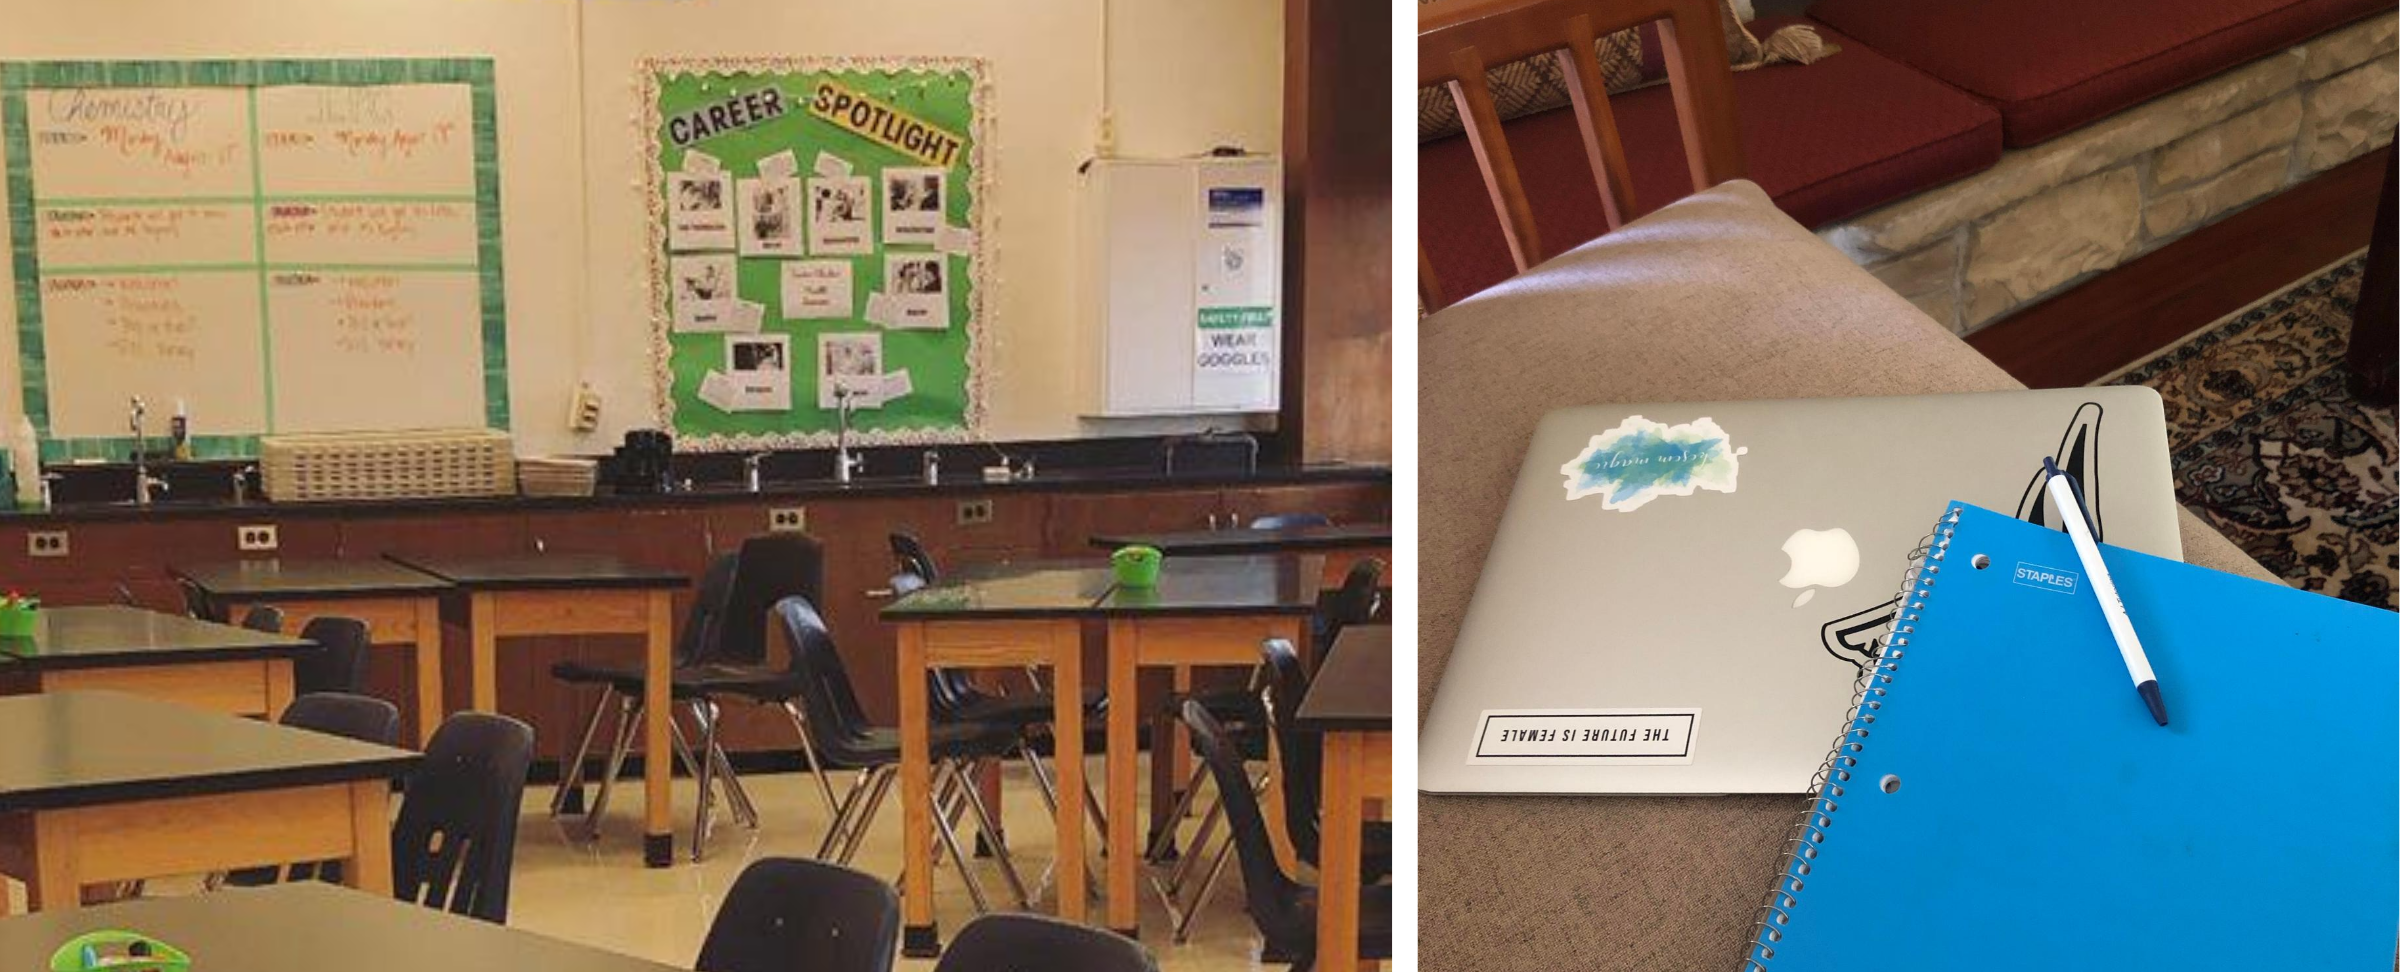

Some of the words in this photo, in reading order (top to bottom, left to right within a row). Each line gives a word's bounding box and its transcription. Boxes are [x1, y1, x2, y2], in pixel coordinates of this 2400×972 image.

[49, 88, 192, 142] Chemistry
[670, 87, 783, 145] CAREER
[814, 84, 959, 166] SPOTLIGHT
[1211, 333, 1256, 348] WEAR
[1197, 351, 1270, 368] GOGGLES
[1596, 450, 1650, 469] magic
[2016, 567, 2074, 588] STAPLES
[1500, 729, 1556, 742] FEMALE
[1561, 729, 1576, 742] IS
[1581, 728, 1637, 742] FUTURE
[1643, 728, 1670, 742] THE
